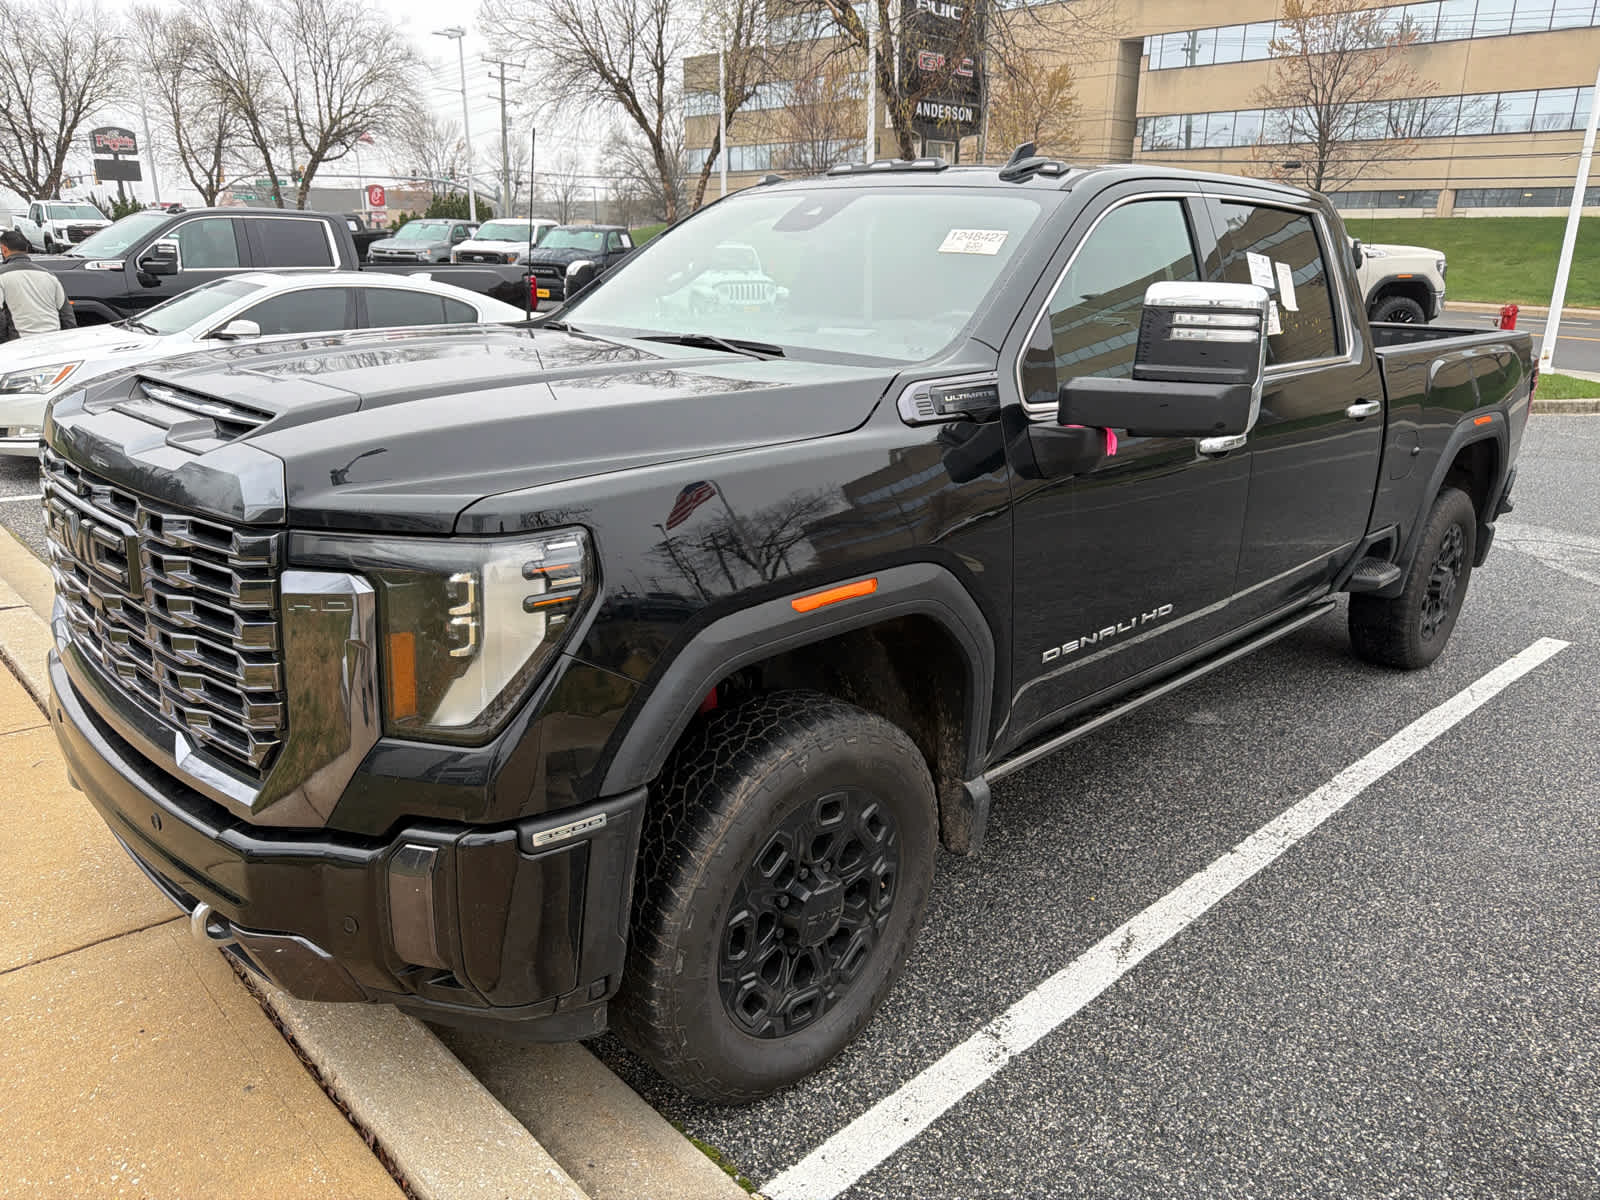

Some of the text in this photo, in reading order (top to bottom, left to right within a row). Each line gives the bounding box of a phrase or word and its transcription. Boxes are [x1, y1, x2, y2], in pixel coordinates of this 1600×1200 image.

[916, 101, 973, 121] ANDERSON
[951, 231, 1008, 243] 1248427
[944, 390, 996, 402] ULTIMATE
[1042, 603, 1174, 664] DENALI HD
